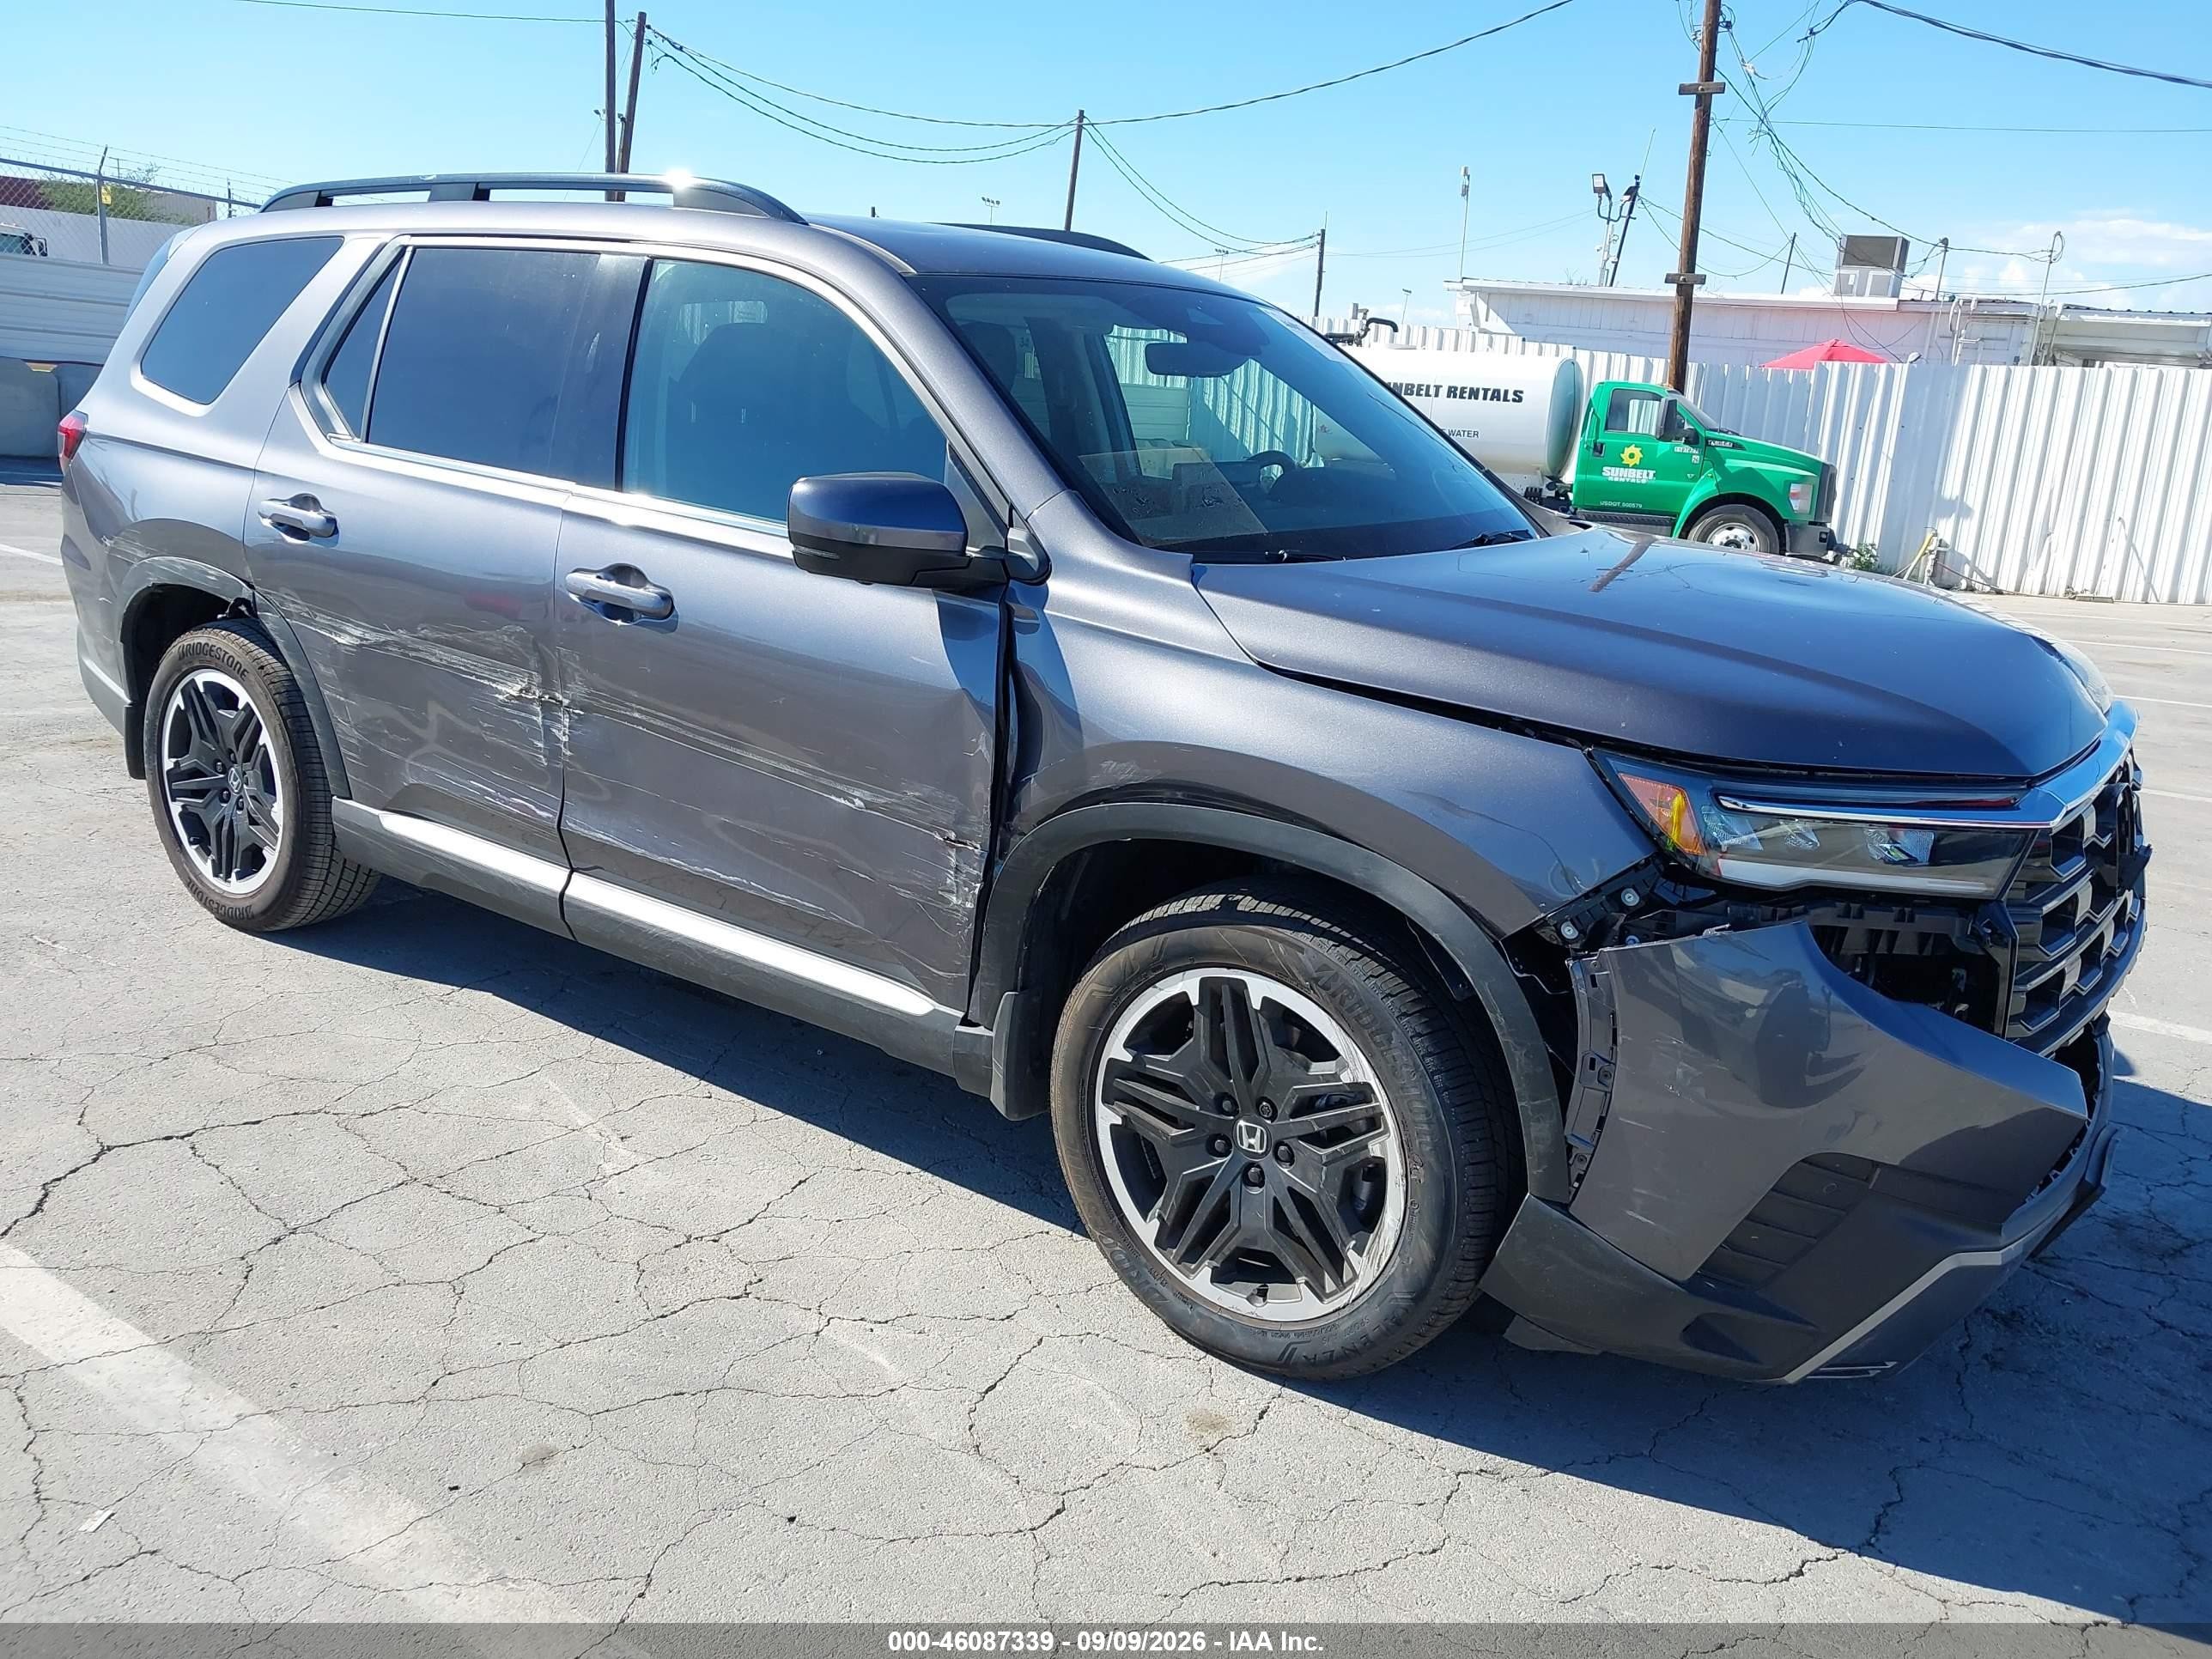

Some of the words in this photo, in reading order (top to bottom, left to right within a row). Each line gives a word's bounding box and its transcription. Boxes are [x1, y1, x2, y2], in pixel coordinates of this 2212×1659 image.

[1387, 382, 1443, 398] NBELT
[1446, 385, 1525, 404] RENTALS
[1448, 428, 1480, 439] WATER
[1602, 466, 1656, 480] SUNBELT
[178, 641, 249, 682] BRIDGESTONE
